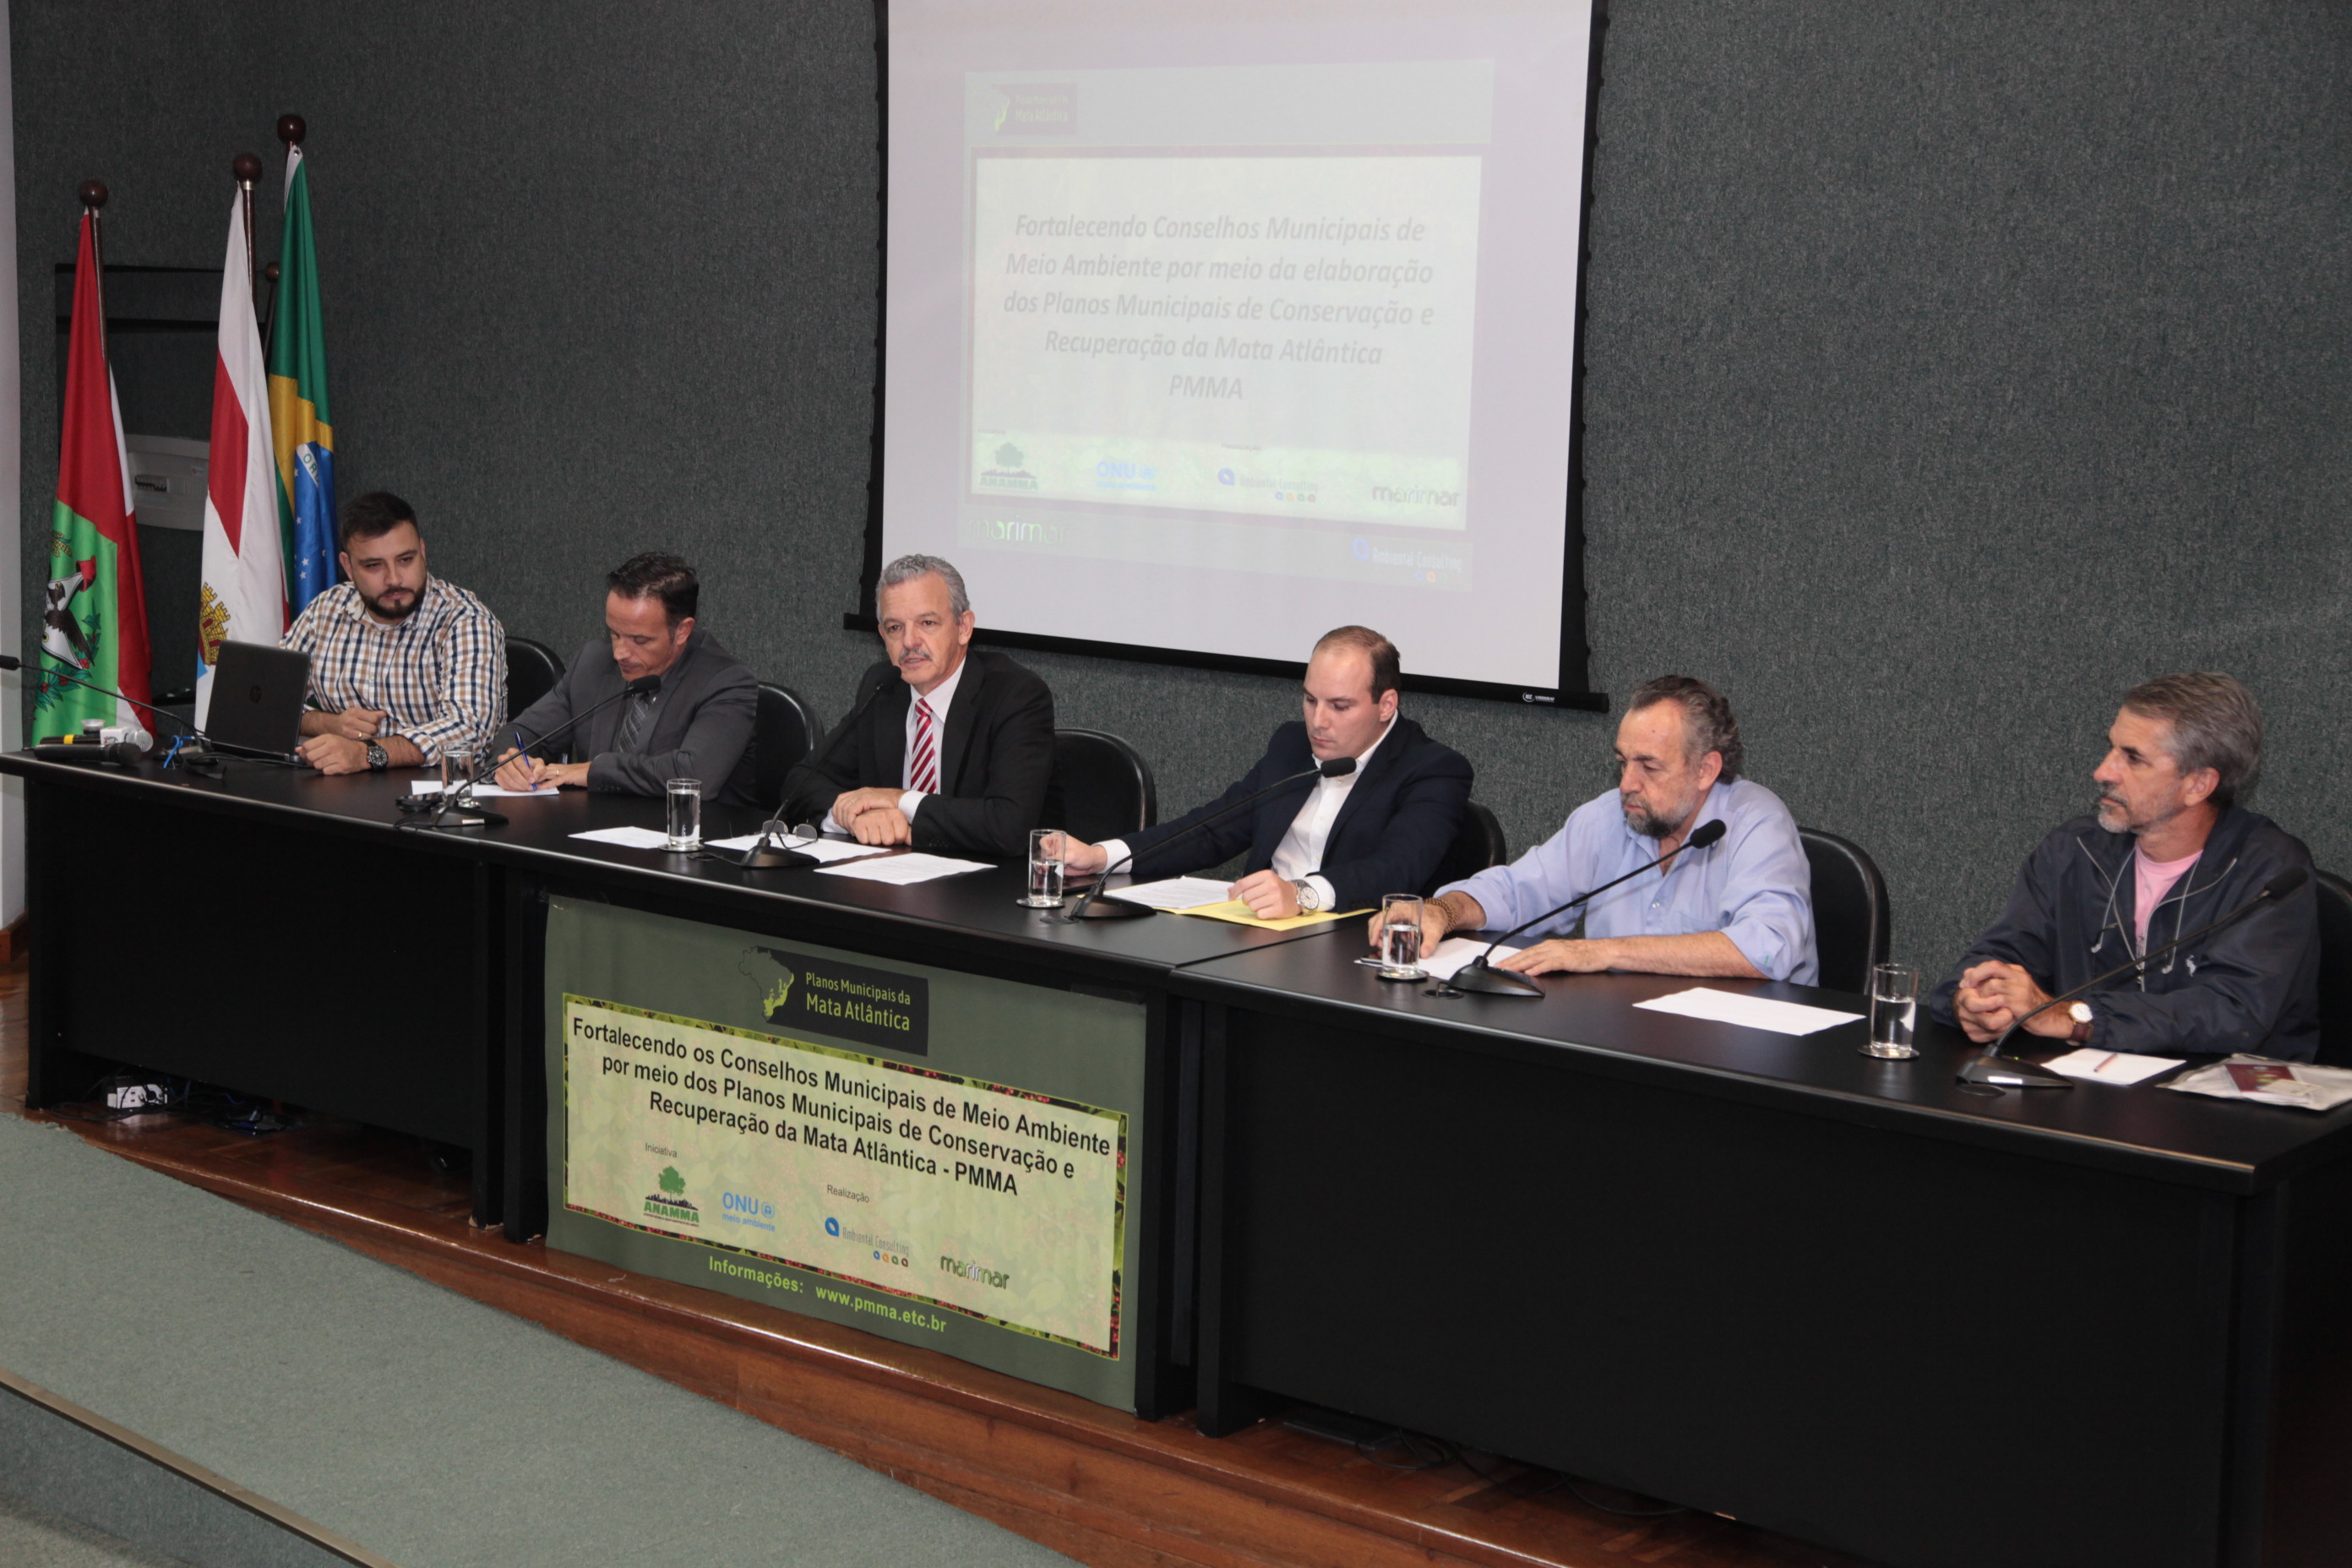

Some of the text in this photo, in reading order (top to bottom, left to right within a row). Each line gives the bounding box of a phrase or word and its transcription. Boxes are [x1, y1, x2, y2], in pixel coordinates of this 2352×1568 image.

[1015, 214, 1425, 247] Fortalecendo Conselhos Municipais de
[1005, 253, 1434, 291] Meio Ambiente por meio da elaboração
[1004, 291, 1434, 331] dos Planos Municipais de Conservação e
[1045, 330, 1382, 366] Recuperação da Mata Atlântica
[1168, 373, 1244, 400] PMMA
[1096, 460, 1136, 480] ONU
[1371, 485, 1460, 507] marimar
[968, 514, 1070, 545] marimar
[806, 972, 911, 1005] Planos Municipais da
[807, 993, 910, 1031] Mata Atlântica
[573, 1017, 1111, 1157] Fortalecendo os Conselhos Municipais de Meio Ambiente
[602, 1056, 1075, 1179] por meio dos Planos Municipais de Conservação e
[645, 1142, 678, 1158] Iniciativa
[650, 1091, 769, 1135] Recuperação
[776, 1119, 797, 1141] da
[803, 1125, 847, 1153] Mata
[853, 1137, 937, 1175] Atlântica
[955, 1161, 1018, 1196] PMMA
[722, 1192, 760, 1216] ONU
[826, 1184, 870, 1203] Realização
[644, 1200, 700, 1223] ANAMMA
[722, 1212, 776, 1232] meio ambiente
[842, 1226, 910, 1257] Ambiental Consulting
[939, 1255, 1010, 1289] marimar
[709, 1256, 946, 1332] Informações: www.pmma.etc.br
